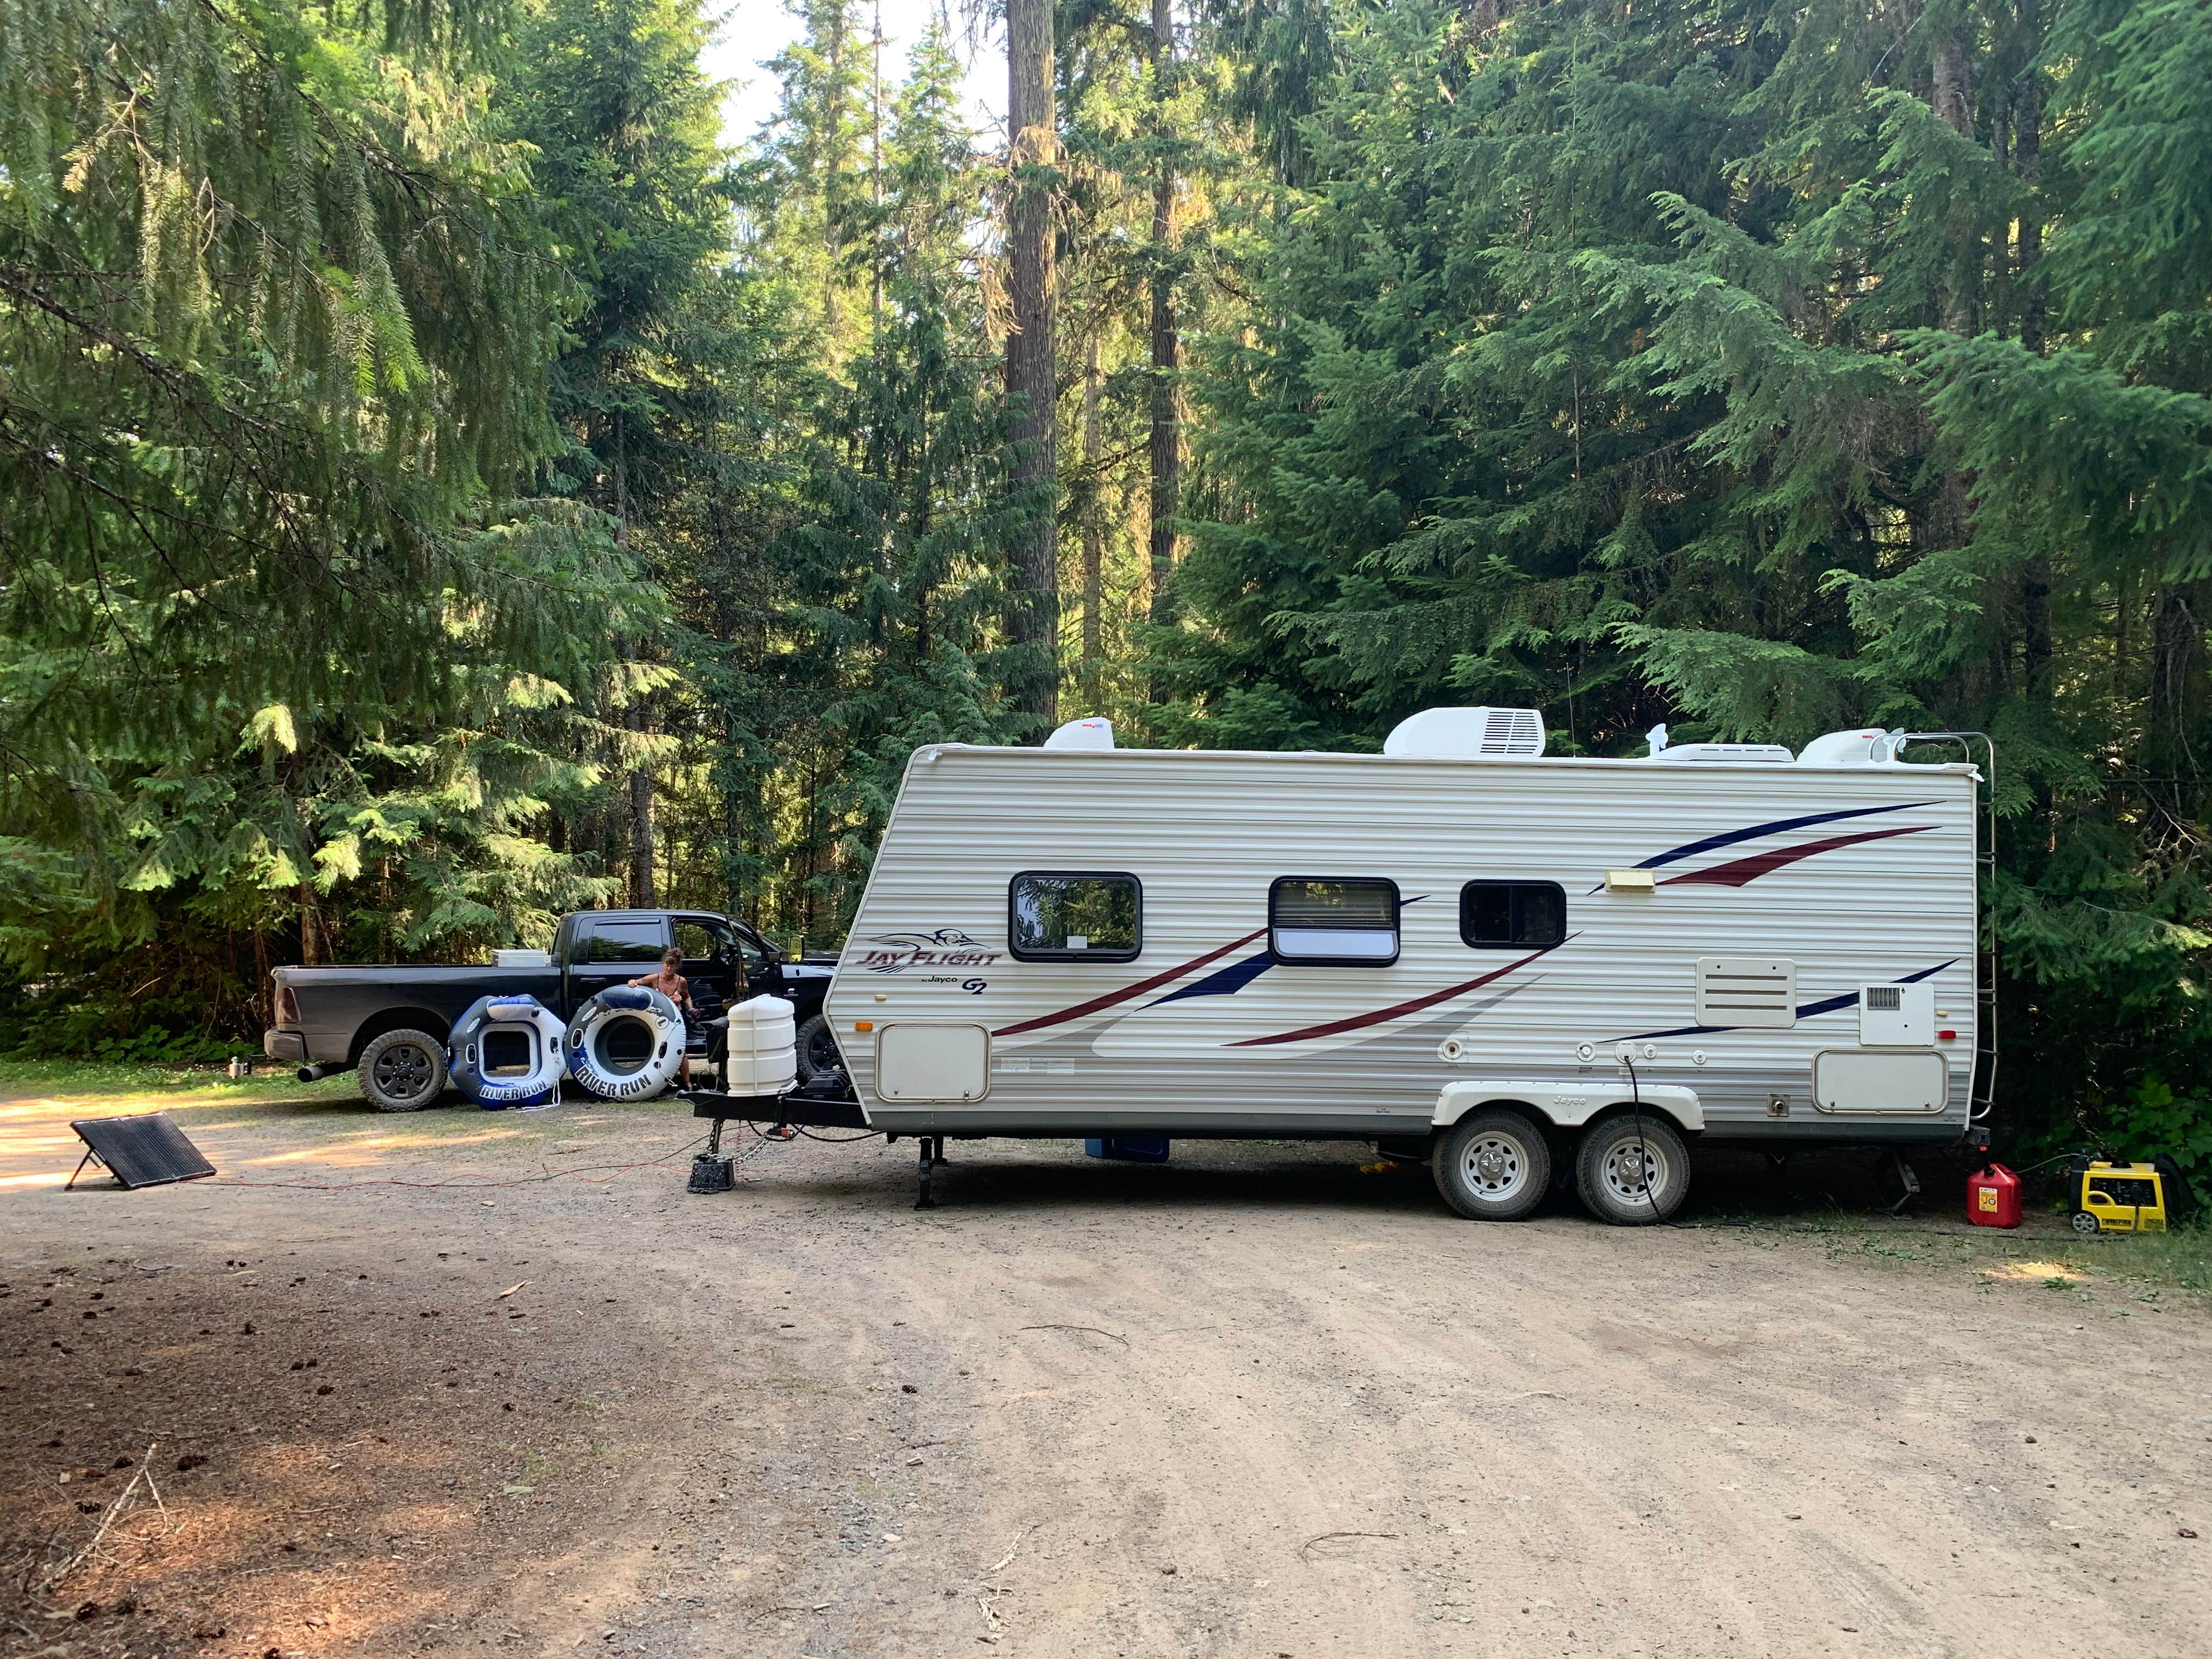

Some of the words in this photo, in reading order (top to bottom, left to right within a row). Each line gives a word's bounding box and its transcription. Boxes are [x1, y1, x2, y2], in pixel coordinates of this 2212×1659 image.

[855, 950, 909, 964] JAY
[907, 951, 1002, 966] FLIGHT
[928, 975, 958, 984] Jayco
[962, 978, 987, 995] G2
[574, 1064, 617, 1097] RIVER
[620, 1074, 652, 1096] RUN
[479, 1085, 520, 1100] RIVER
[521, 1080, 548, 1098] RUN
[1554, 1096, 1586, 1106] Jayco
